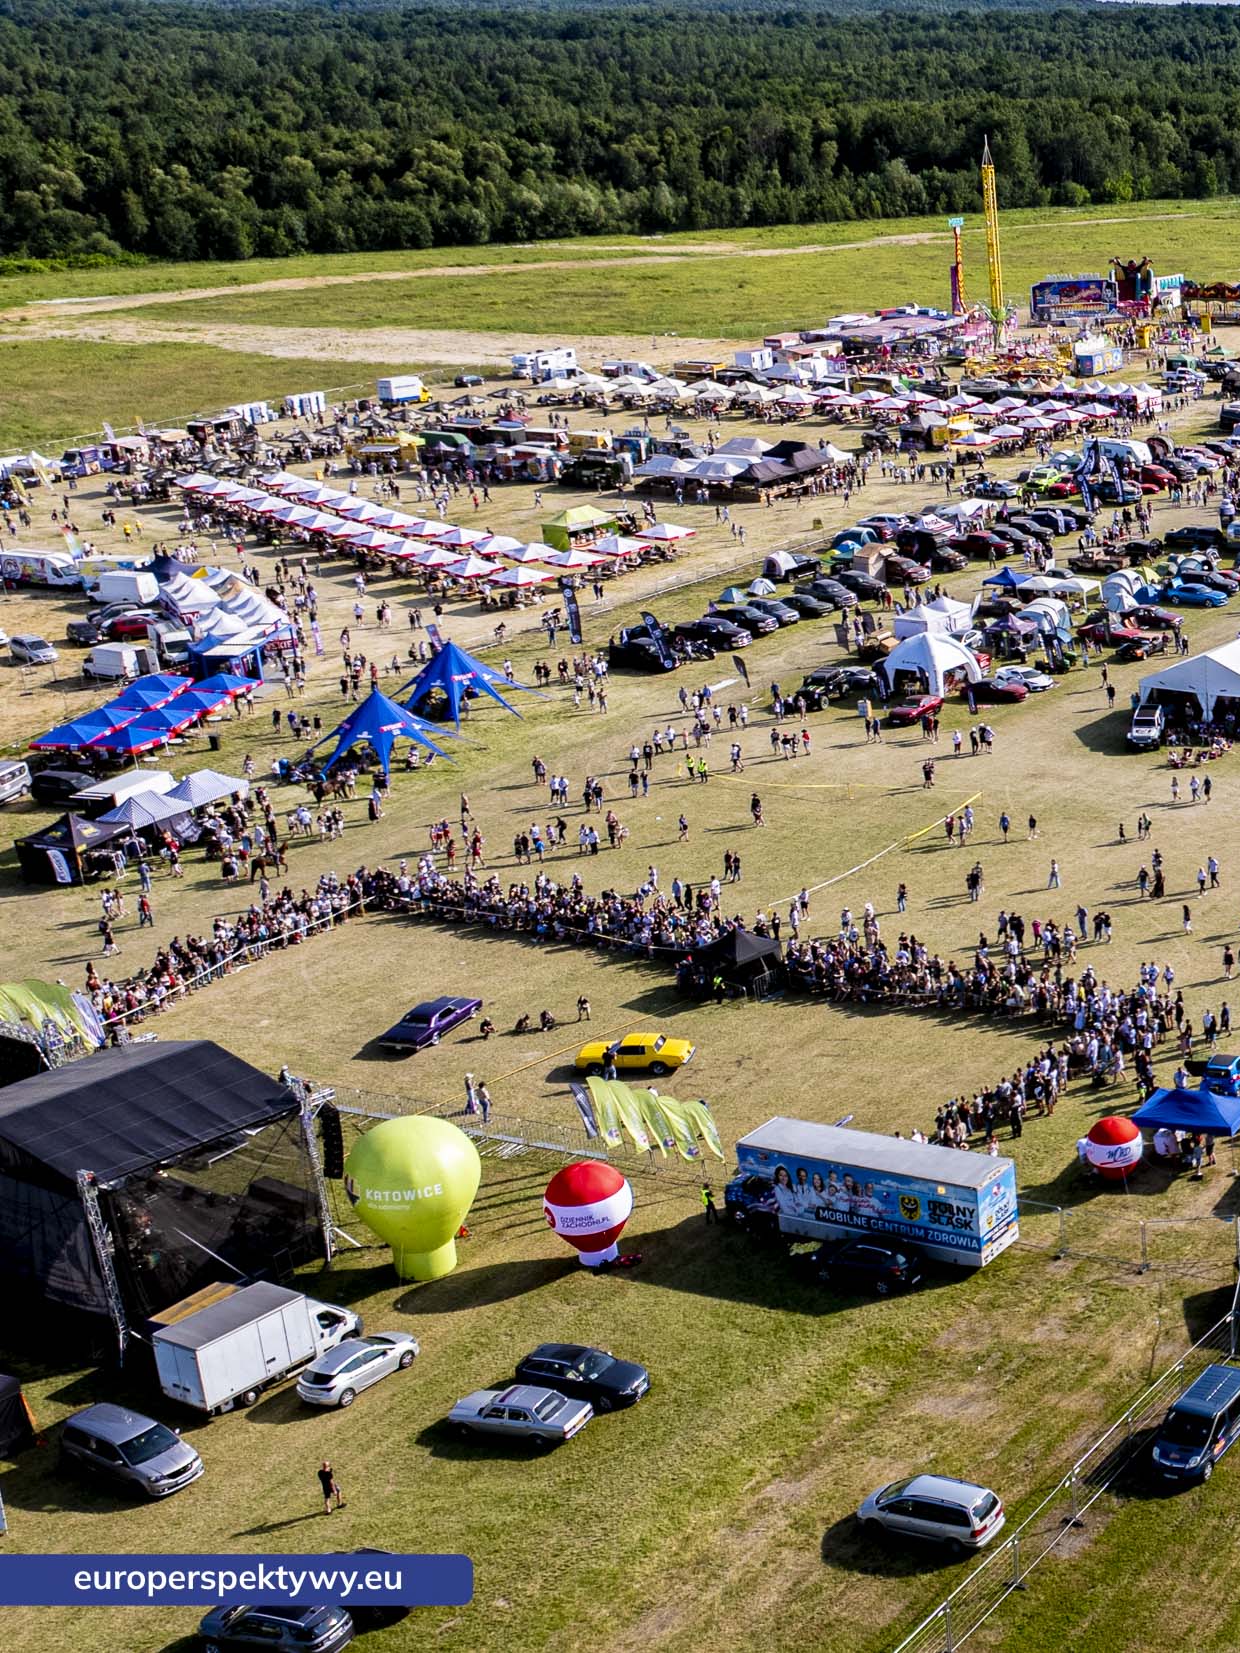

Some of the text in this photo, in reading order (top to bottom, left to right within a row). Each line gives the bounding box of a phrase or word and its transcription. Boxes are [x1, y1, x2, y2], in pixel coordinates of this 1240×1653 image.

[365, 1183, 443, 1201] KATOWICE
[928, 1200, 976, 1219] DOLNY
[818, 1208, 979, 1249] MOBILNE CENTRUM ZDROWIA
